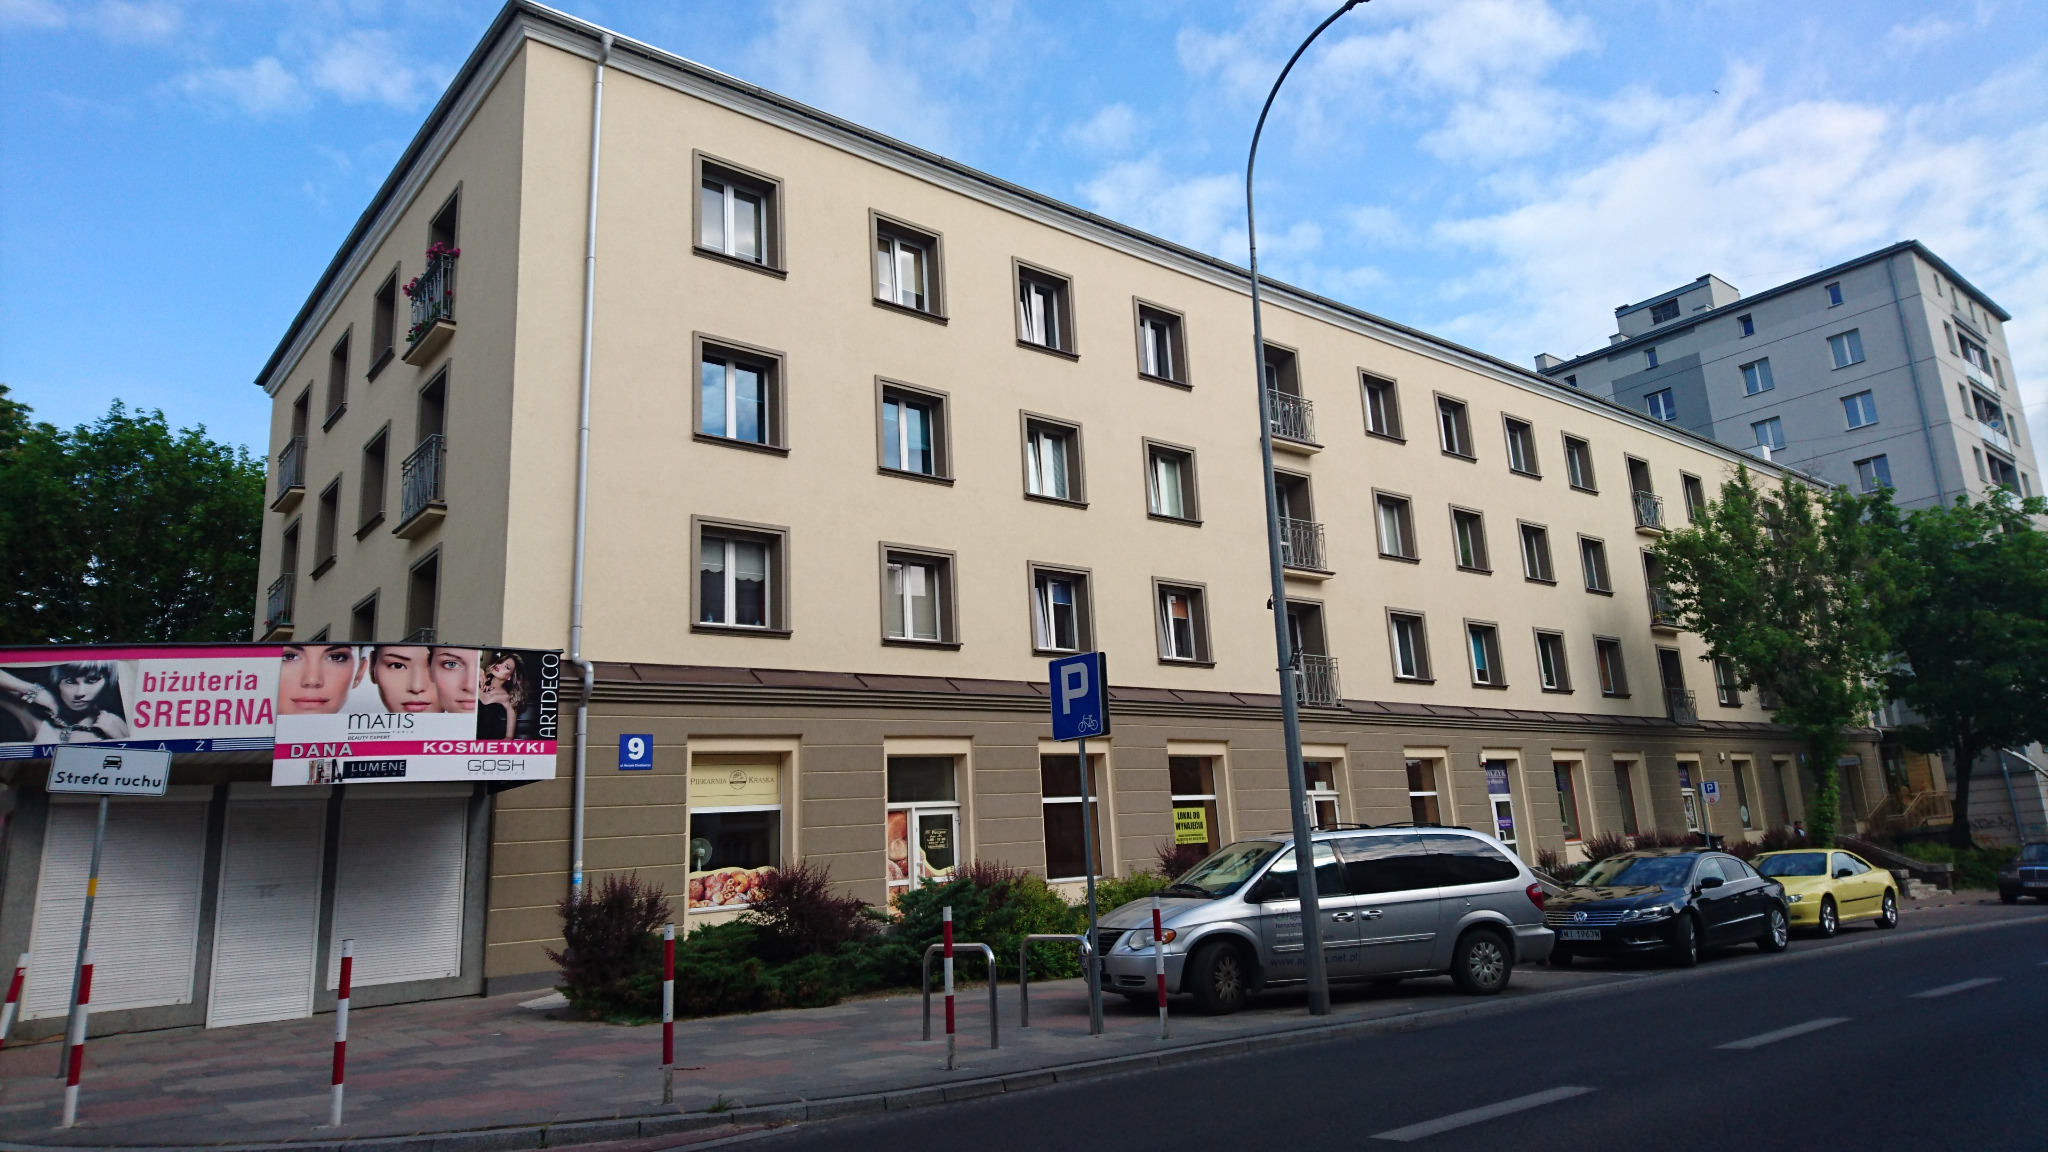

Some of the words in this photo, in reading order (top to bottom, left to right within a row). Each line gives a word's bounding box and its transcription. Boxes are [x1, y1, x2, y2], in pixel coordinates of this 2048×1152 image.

[142, 670, 258, 693] biżuteria
[1061, 662, 1089, 715] P
[538, 653, 559, 738] ARTDECO
[133, 698, 274, 729] SREBRNA
[290, 742, 353, 758] DANA
[422, 741, 545, 754] KOSMETYKI
[628, 737, 645, 760] 9
[351, 762, 406, 772] LUMENE
[467, 759, 525, 772] GOSH
[54, 771, 109, 786] Strefa
[114, 774, 162, 788] ruchu
[1706, 783, 1714, 793] P
[1177, 811, 1192, 820] LOKAL
[1192, 811, 1201, 820] DO
[1175, 821, 1204, 832] WYNAJĘCIA
